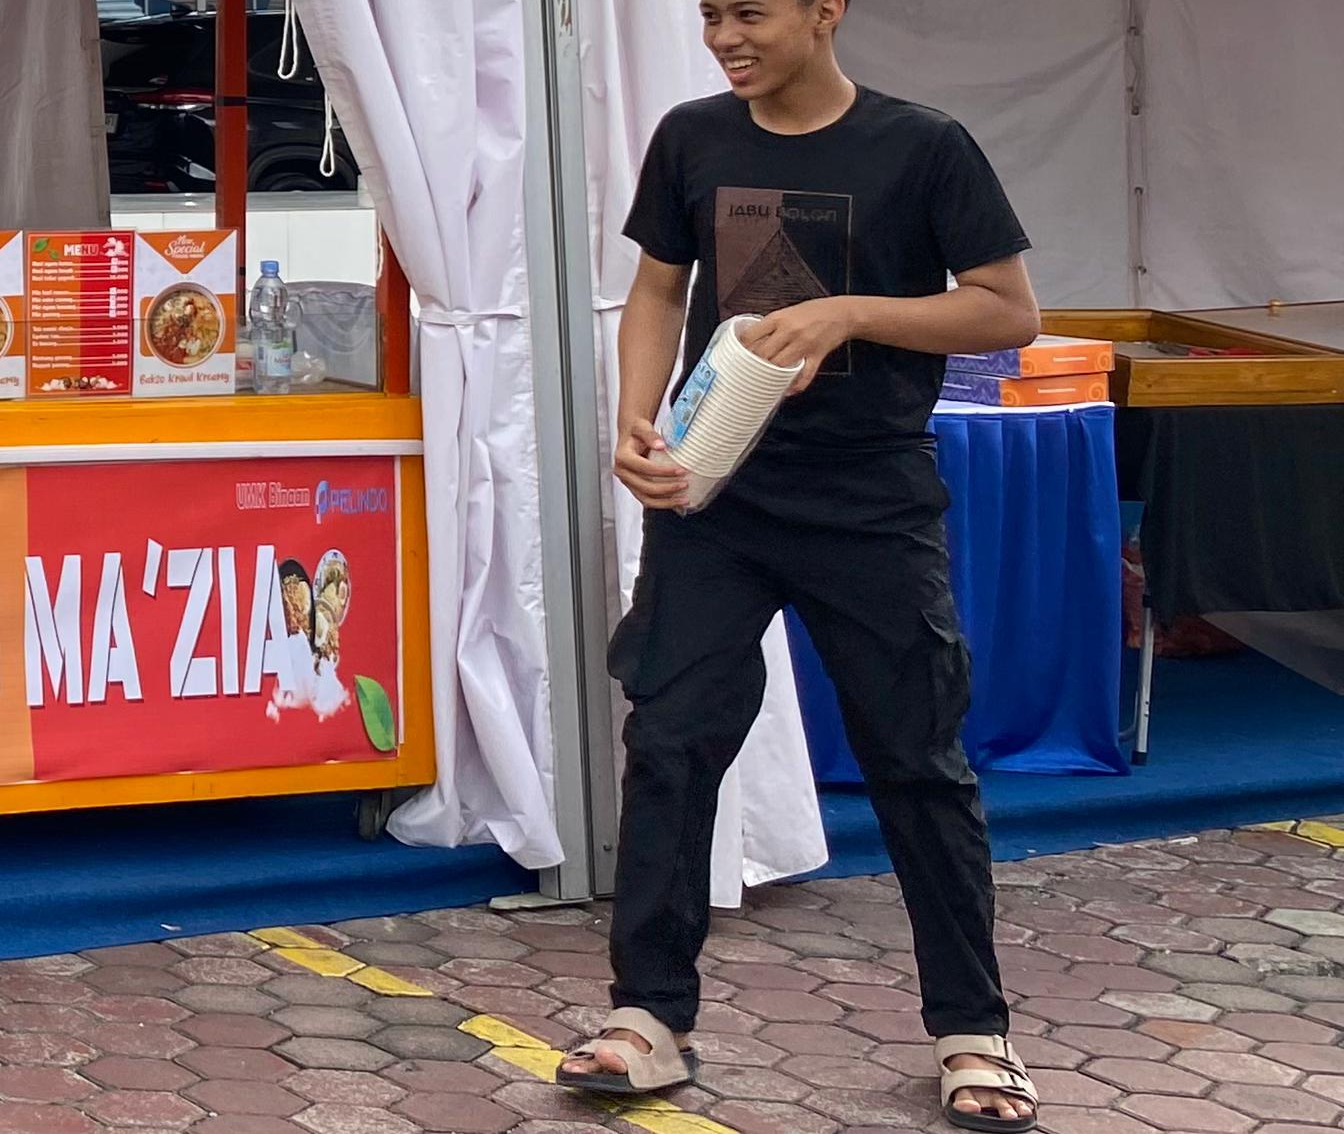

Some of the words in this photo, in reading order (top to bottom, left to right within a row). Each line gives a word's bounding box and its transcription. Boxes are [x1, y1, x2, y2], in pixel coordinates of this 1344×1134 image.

[63, 243, 99, 256] MENU
[164, 241, 206, 256] Special
[236, 482, 267, 509] UMK
[269, 481, 310, 507] Binaan
[330, 488, 388, 514] PELINDO
[25, 538, 290, 707] MA'ZIA
